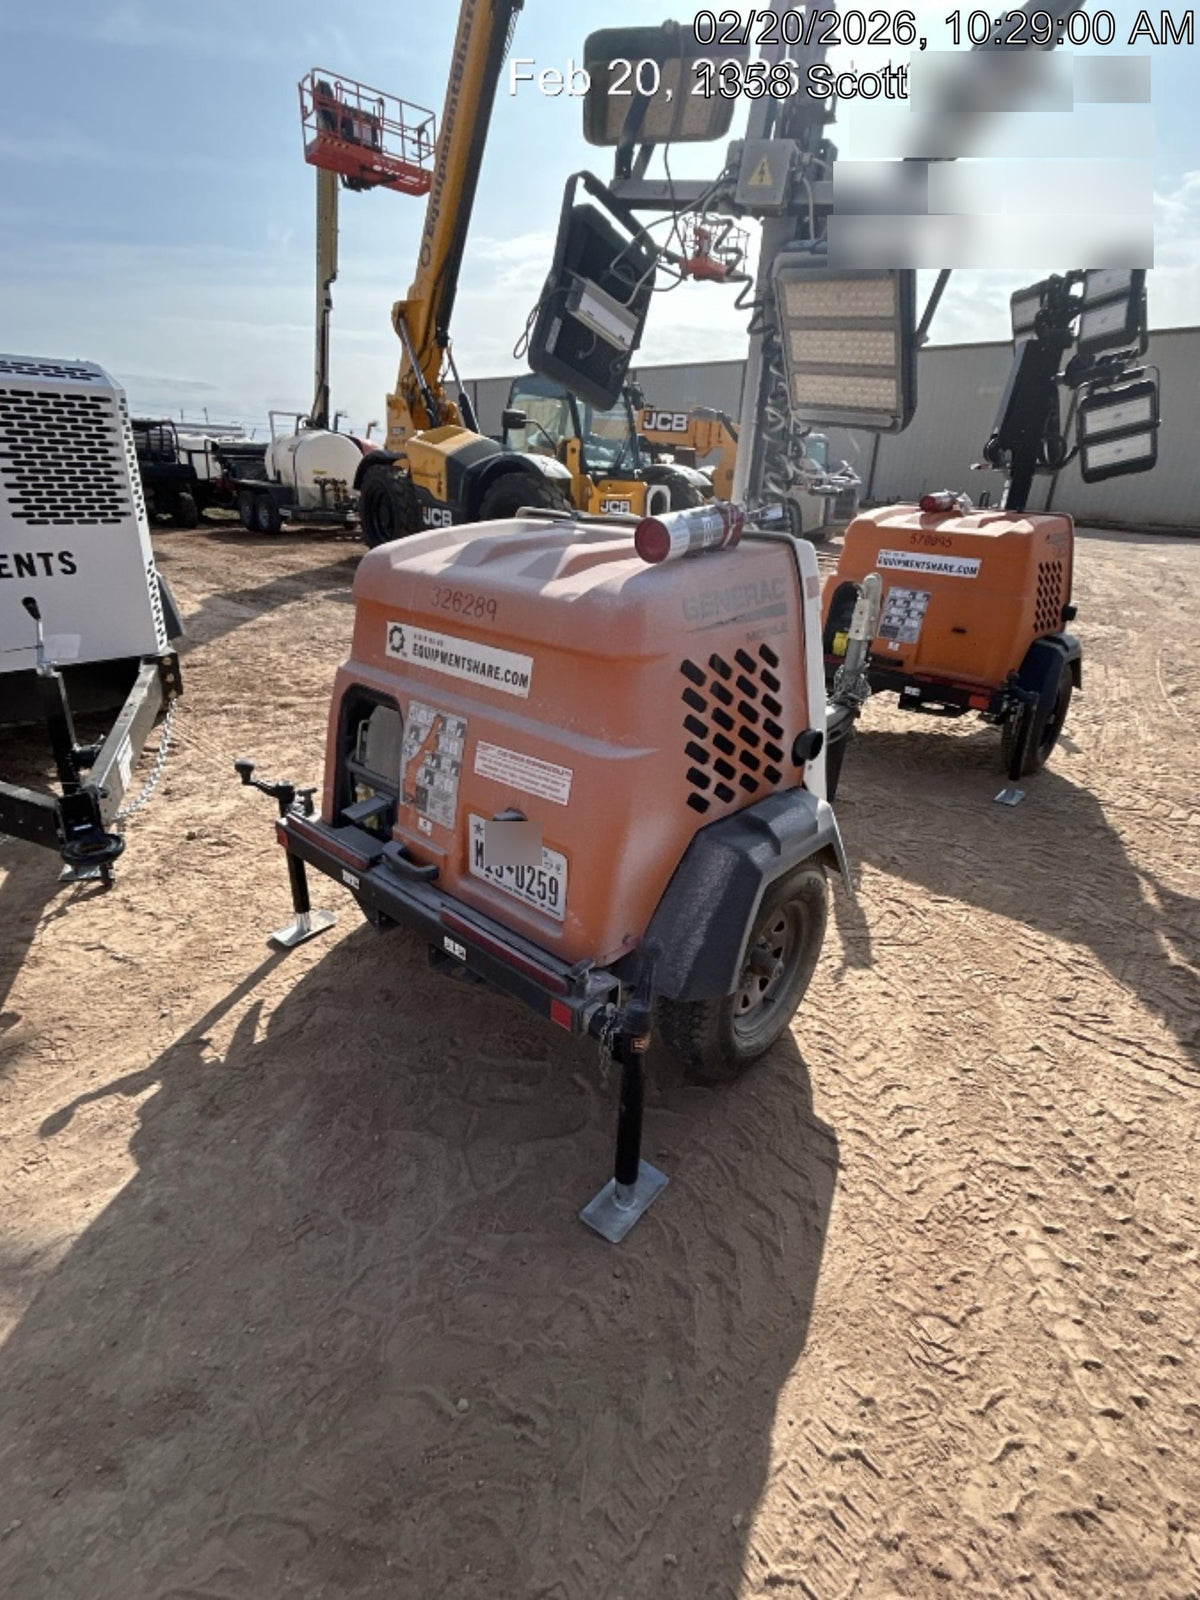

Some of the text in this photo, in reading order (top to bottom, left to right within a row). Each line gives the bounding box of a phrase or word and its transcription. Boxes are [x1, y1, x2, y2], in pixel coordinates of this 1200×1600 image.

[643, 411, 688, 432] JCB
[423, 506, 453, 527] JCB
[600, 500, 631, 513] JCB
[431, 586, 498, 622] 326289
[411, 642, 530, 689] EQUIPMENTSHARE.COM
